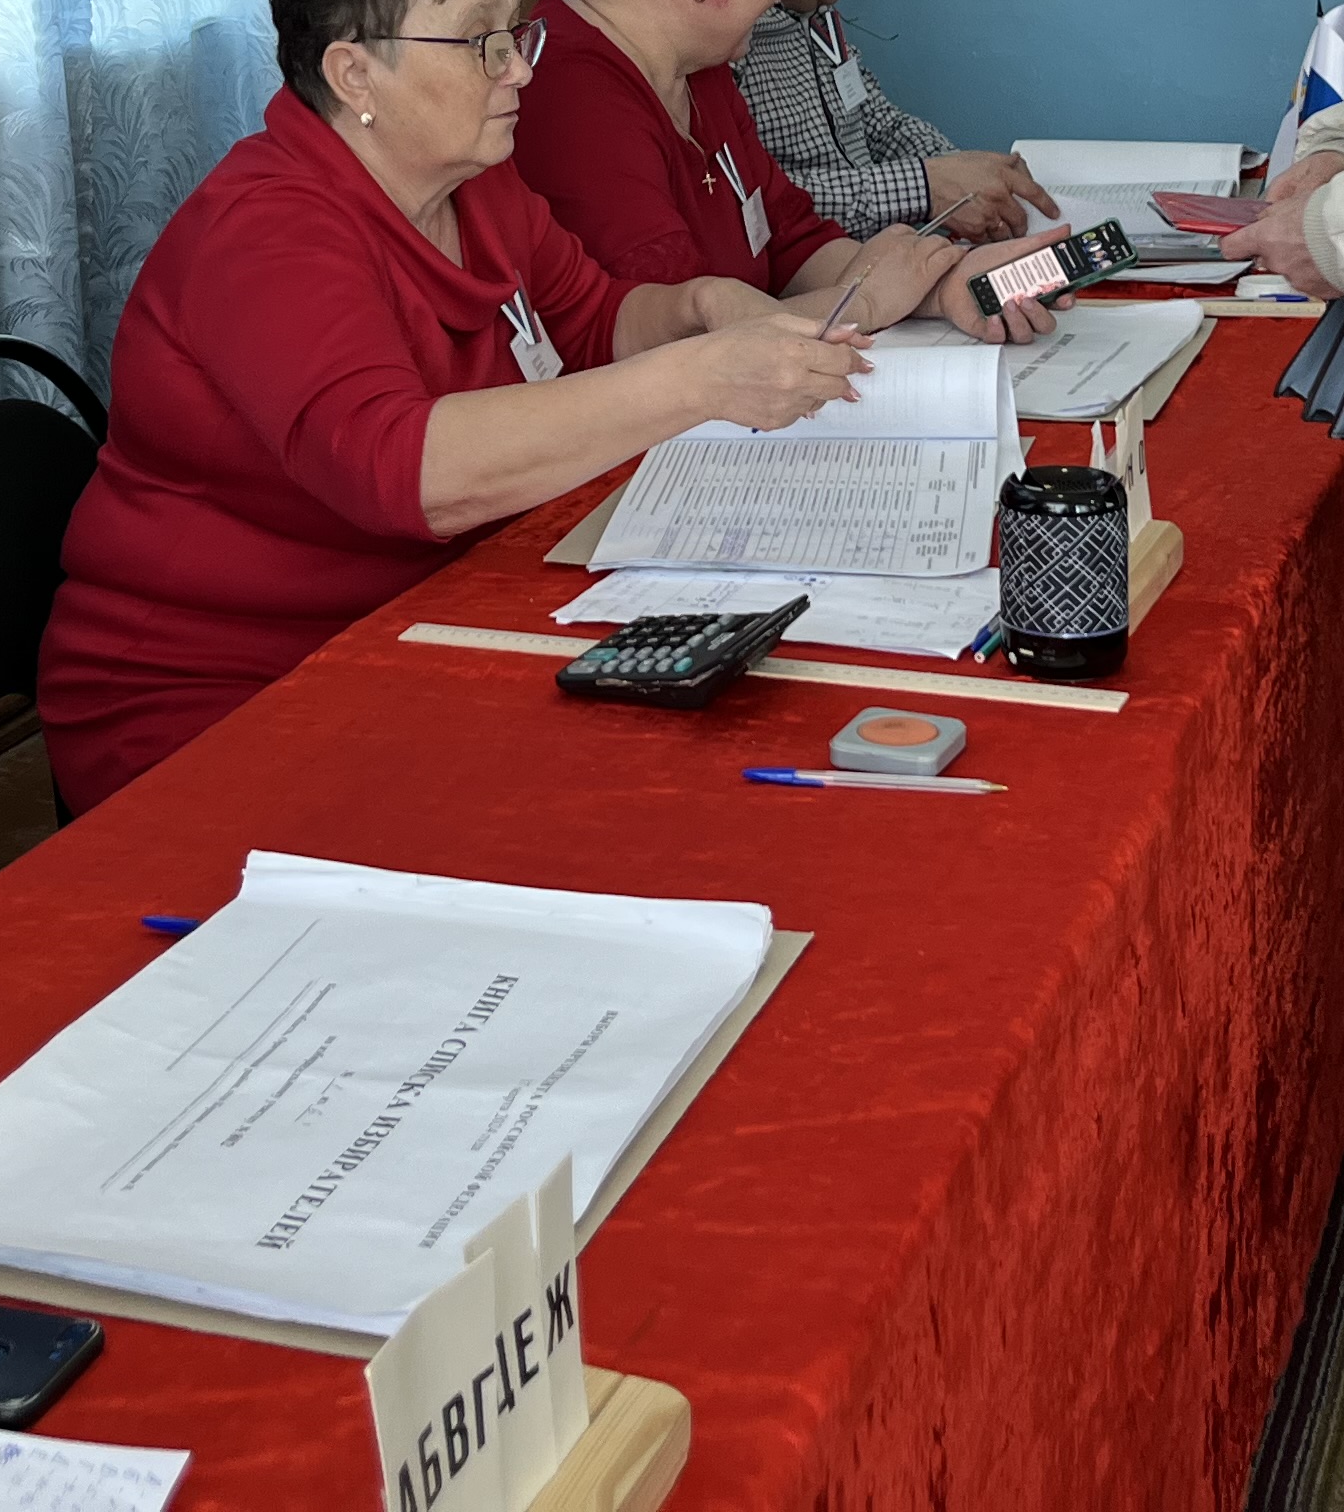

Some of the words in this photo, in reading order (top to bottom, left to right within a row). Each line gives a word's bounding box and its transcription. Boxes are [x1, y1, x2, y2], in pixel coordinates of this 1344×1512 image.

[453, 973, 519, 1033] КНИГА
[386, 1038, 467, 1109] СПИСКА
[474, 1104, 539, 1182] РОССИЙСКОЙ
[255, 1115, 403, 1249] ИЗБИРАТЕЛЕЙ
